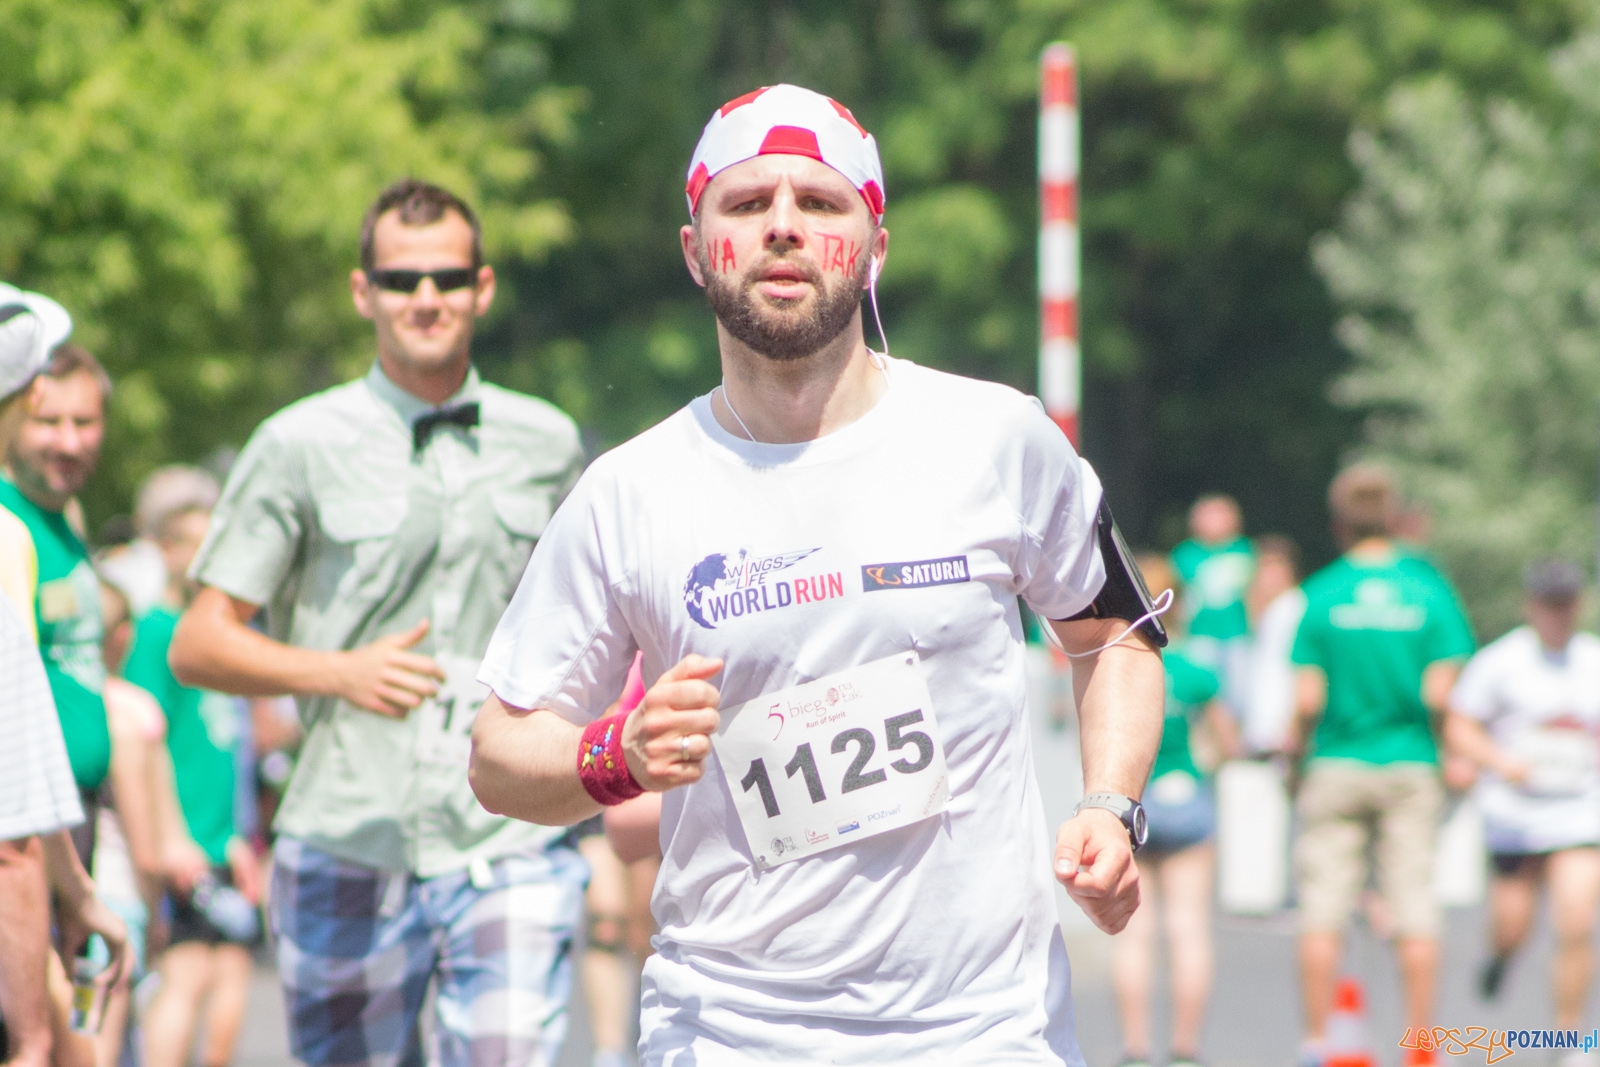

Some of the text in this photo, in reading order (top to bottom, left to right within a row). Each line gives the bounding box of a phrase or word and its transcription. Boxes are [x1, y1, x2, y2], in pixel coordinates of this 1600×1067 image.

[813, 231, 862, 279] TAK
[727, 556, 784, 579] WINGS
[901, 560, 967, 585] SATURN
[736, 571, 768, 590] LIFE
[767, 700, 827, 742] 5 bieg
[806, 711, 847, 729] Run of Spirit
[740, 708, 934, 818] 1125
